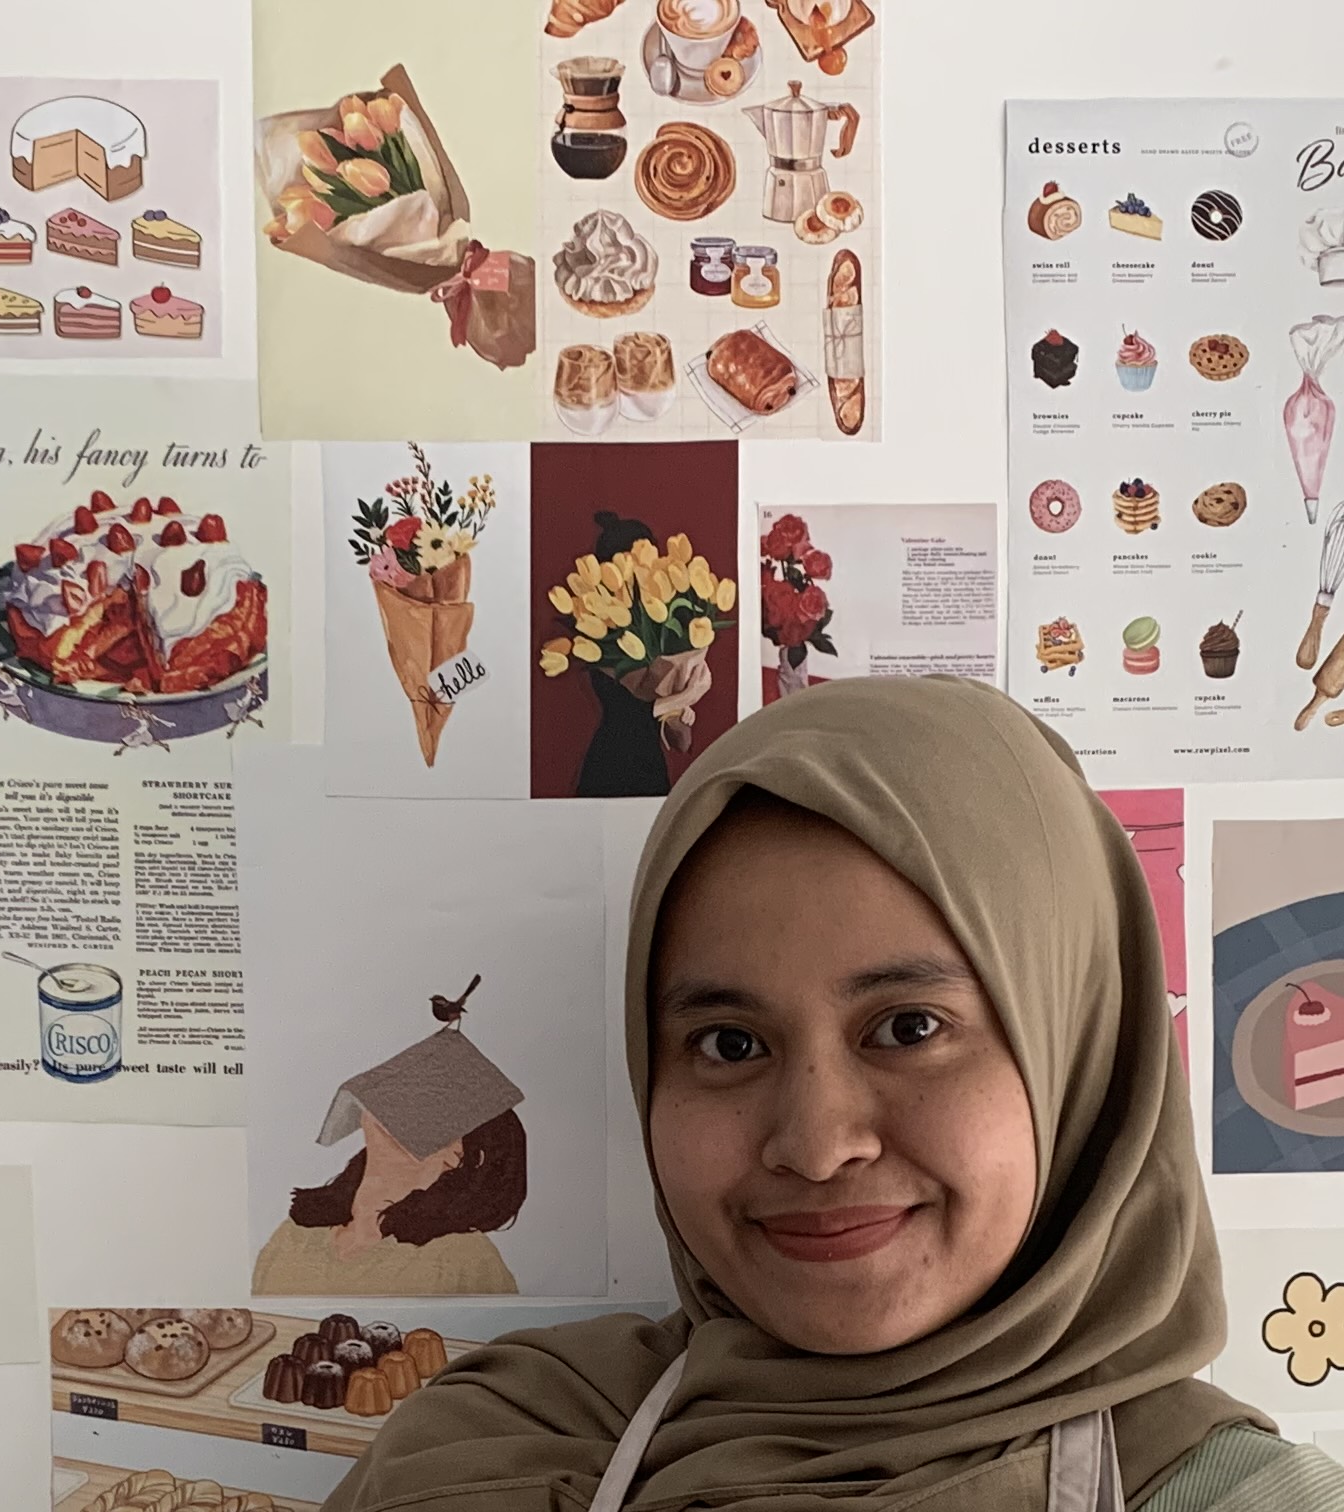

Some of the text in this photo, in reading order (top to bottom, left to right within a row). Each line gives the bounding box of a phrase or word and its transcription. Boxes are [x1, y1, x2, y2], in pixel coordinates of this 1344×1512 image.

[1230, 132, 1253, 148] FREE
[1028, 137, 1122, 155] desserts
[1191, 261, 1214, 269] donut
[1112, 413, 1144, 421] cupcake
[1191, 410, 1232, 419] cherry pie
[23, 428, 61, 465] his
[62, 428, 148, 488] fancy
[163, 440, 228, 469] turns
[240, 440, 268, 470] to
[763, 511, 772, 519] 16
[1113, 553, 1149, 561] pancakes
[1191, 552, 1217, 560] cookie
[438, 657, 486, 700] hello
[1194, 694, 1226, 702] cupcake
[1173, 746, 1251, 755] www.rawpixel.com
[140, 780, 208, 788] STRAWBERRY
[172, 792, 232, 800] SHORTCAKE
[175, 969, 207, 977] PECAN
[211, 970, 243, 978] SHORT
[48, 1023, 112, 1056] CRISCO
[156, 1063, 187, 1074] taste
[193, 1062, 217, 1074] will
[223, 1062, 244, 1075] tell
